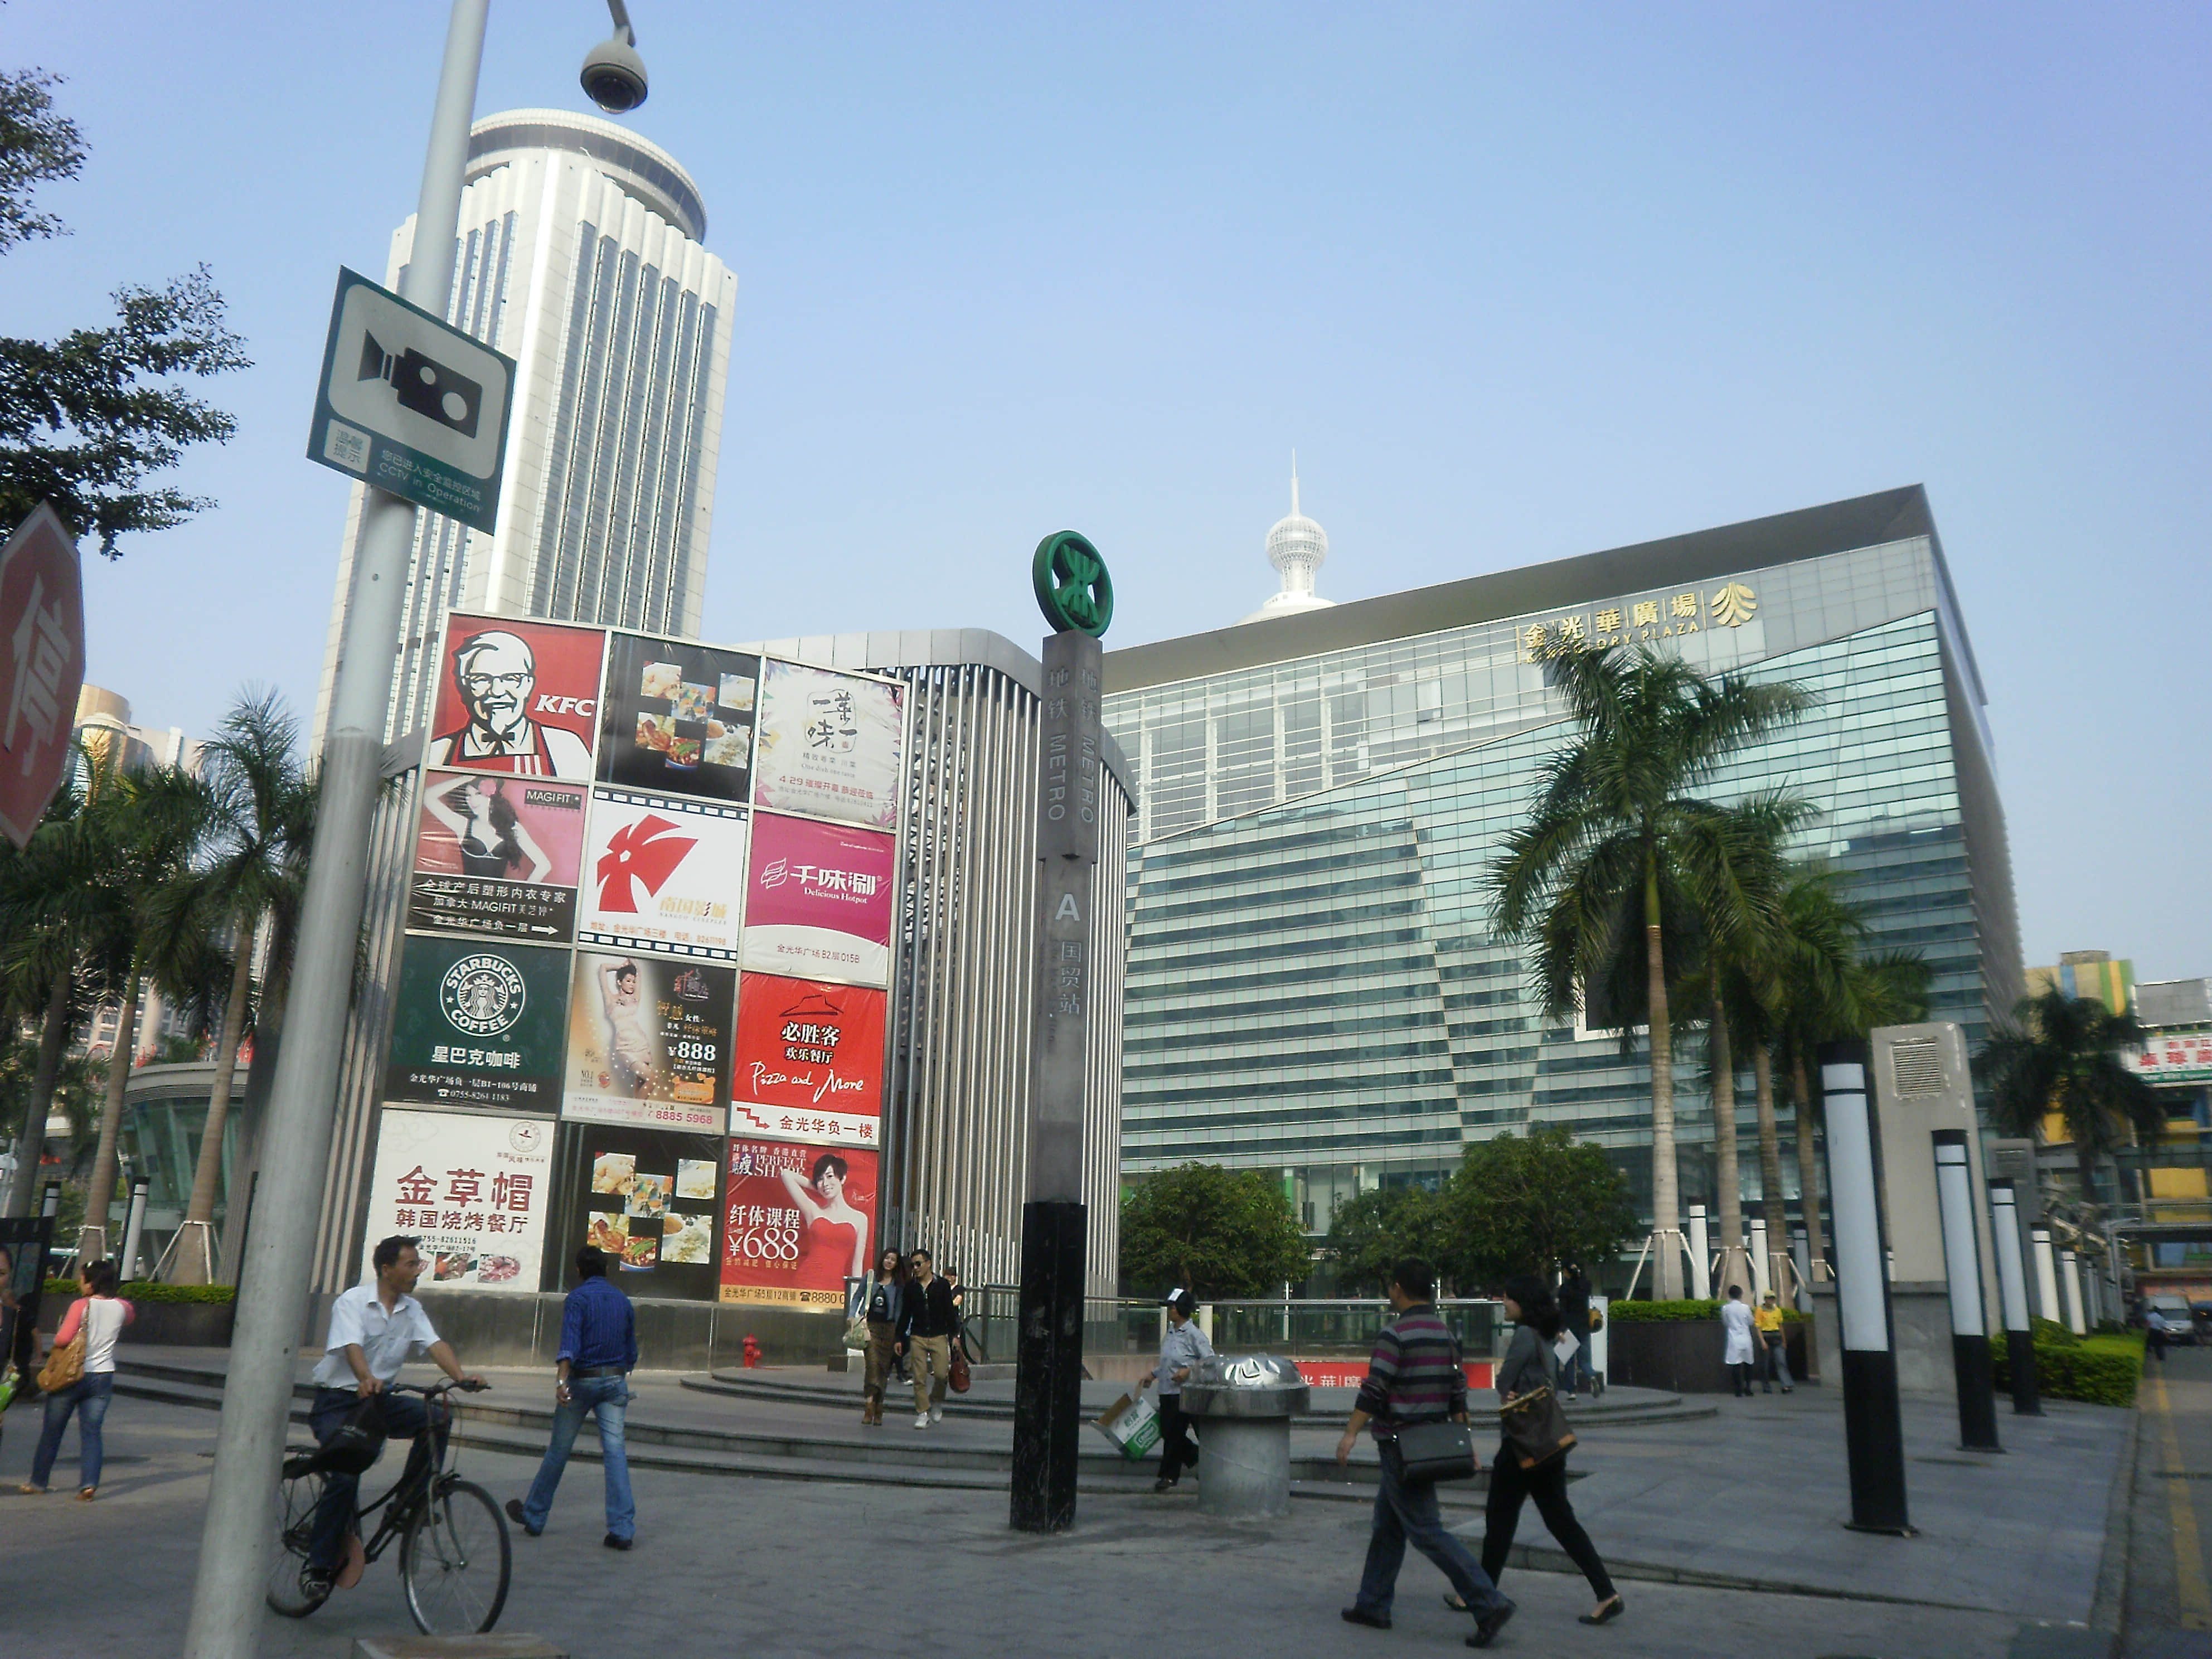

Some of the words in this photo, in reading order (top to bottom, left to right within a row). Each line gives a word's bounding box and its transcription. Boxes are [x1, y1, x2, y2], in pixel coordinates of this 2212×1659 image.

[428, 483, 480, 512] Operation
[1642, 621, 1699, 641] PLAZA
[535, 695, 595, 716] KFC
[1048, 667, 1069, 719] 地铁
[1081, 668, 1098, 724] 地铁
[1048, 734, 1066, 821] METRO
[1081, 735, 1096, 824] METRO
[527, 790, 571, 803] MAGIFIT
[790, 865, 876, 896] 千味涮
[433, 896, 468, 909] 加拿大
[471, 900, 517, 913] MAGIFIT
[804, 886, 840, 900] Delicious
[841, 893, 867, 904] Hotpot
[1055, 893, 1081, 921] A
[447, 958, 521, 995] STARBUCKS
[1059, 940, 1082, 1015] 国贸站
[450, 1009, 509, 1032] COFFEE
[781, 1021, 840, 1046] 必胜客
[431, 1045, 521, 1069] 星巴克咖啡
[784, 1046, 833, 1064] 欢乐餐厅
[750, 1061, 787, 1096] Pizza
[791, 1071, 814, 1086] and
[812, 1068, 864, 1103] More
[656, 1110, 683, 1122] 8885
[686, 1113, 712, 1124] 5968
[780, 1115, 874, 1139] 金光华负一楼
[754, 1164, 806, 1178] SHPE
[756, 1153, 807, 1168] PERFECT
[395, 1165, 533, 1212] 金草帽
[395, 1208, 528, 1234] 韩国烧烤餐厅
[729, 1204, 800, 1229] 纤体课程
[727, 1226, 799, 1261] ¥688
